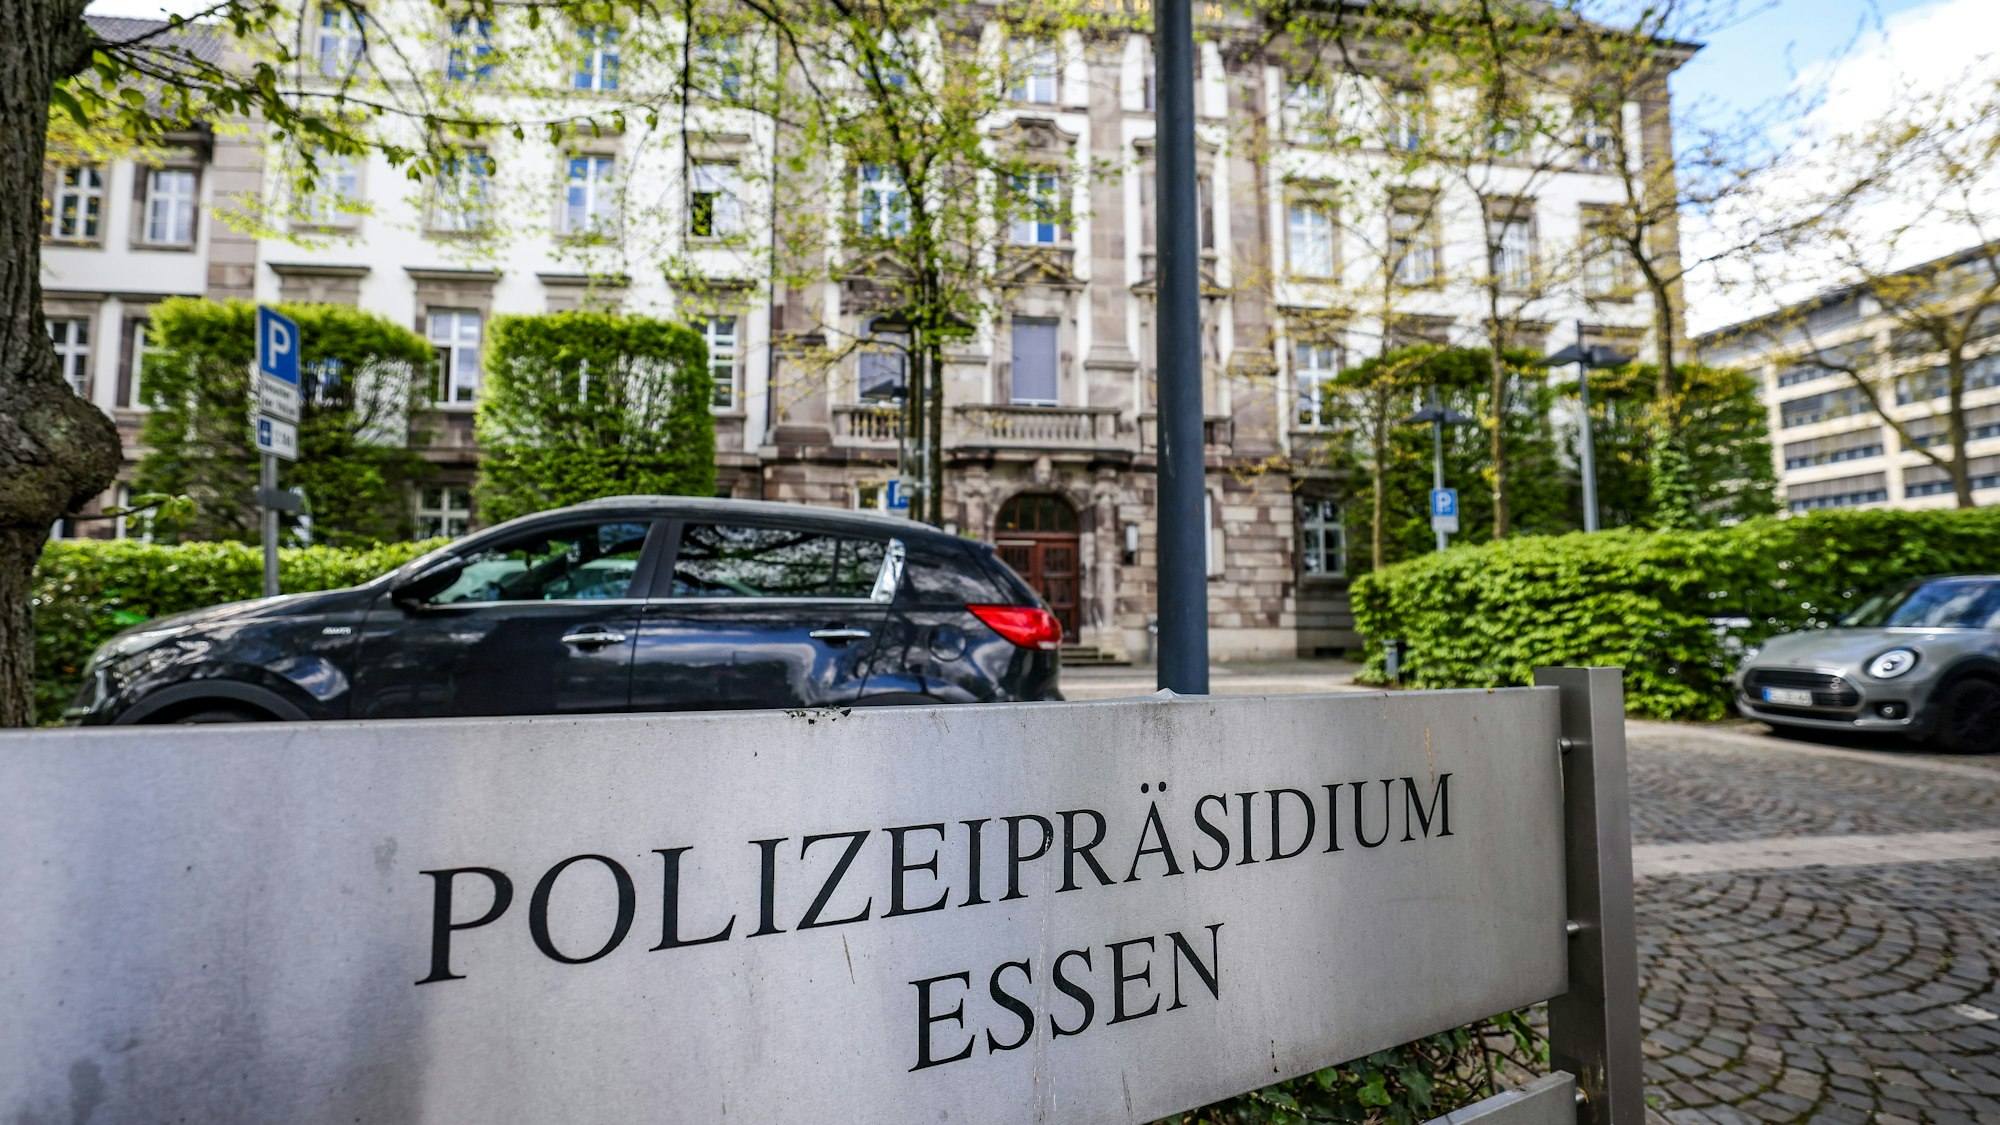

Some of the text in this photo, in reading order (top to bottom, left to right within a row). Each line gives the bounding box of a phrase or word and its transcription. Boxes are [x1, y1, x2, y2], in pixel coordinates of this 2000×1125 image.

[268, 318, 292, 370] P
[414, 772, 1455, 987] POLIZEIPRÄSIDIUM
[907, 922, 1225, 1074] ESSEN
